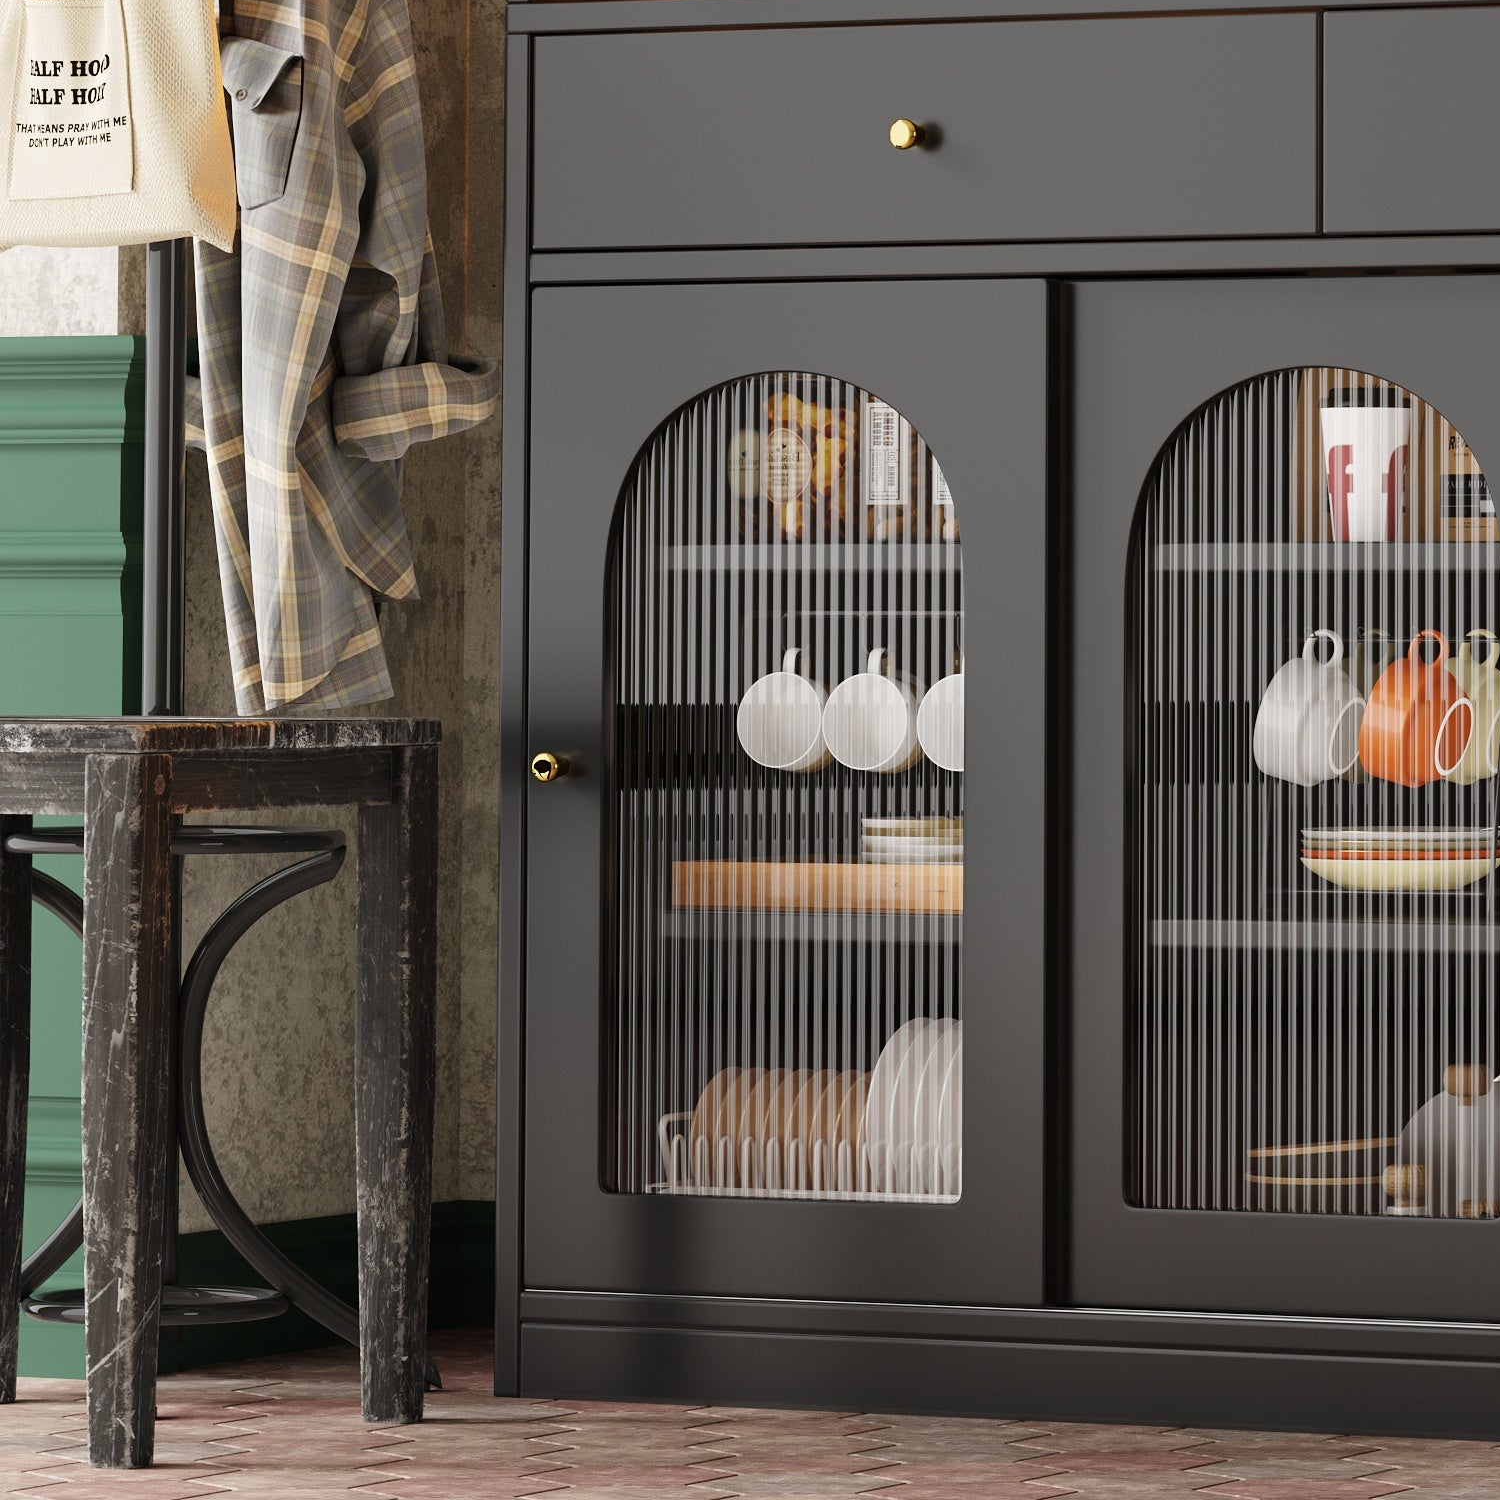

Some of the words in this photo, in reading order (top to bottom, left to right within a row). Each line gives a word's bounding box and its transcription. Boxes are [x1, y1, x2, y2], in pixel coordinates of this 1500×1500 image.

[29, 87, 66, 105] HALF
[16, 123, 36, 134] THAT
[67, 123, 90, 133] PRAY
[91, 117, 110, 131] WITH
[113, 115, 127, 127] ME
[28, 137, 49, 148] DON'T
[52, 137, 75, 148] PLAY
[78, 134, 98, 146] WITH
[99, 132, 112, 143] ME
